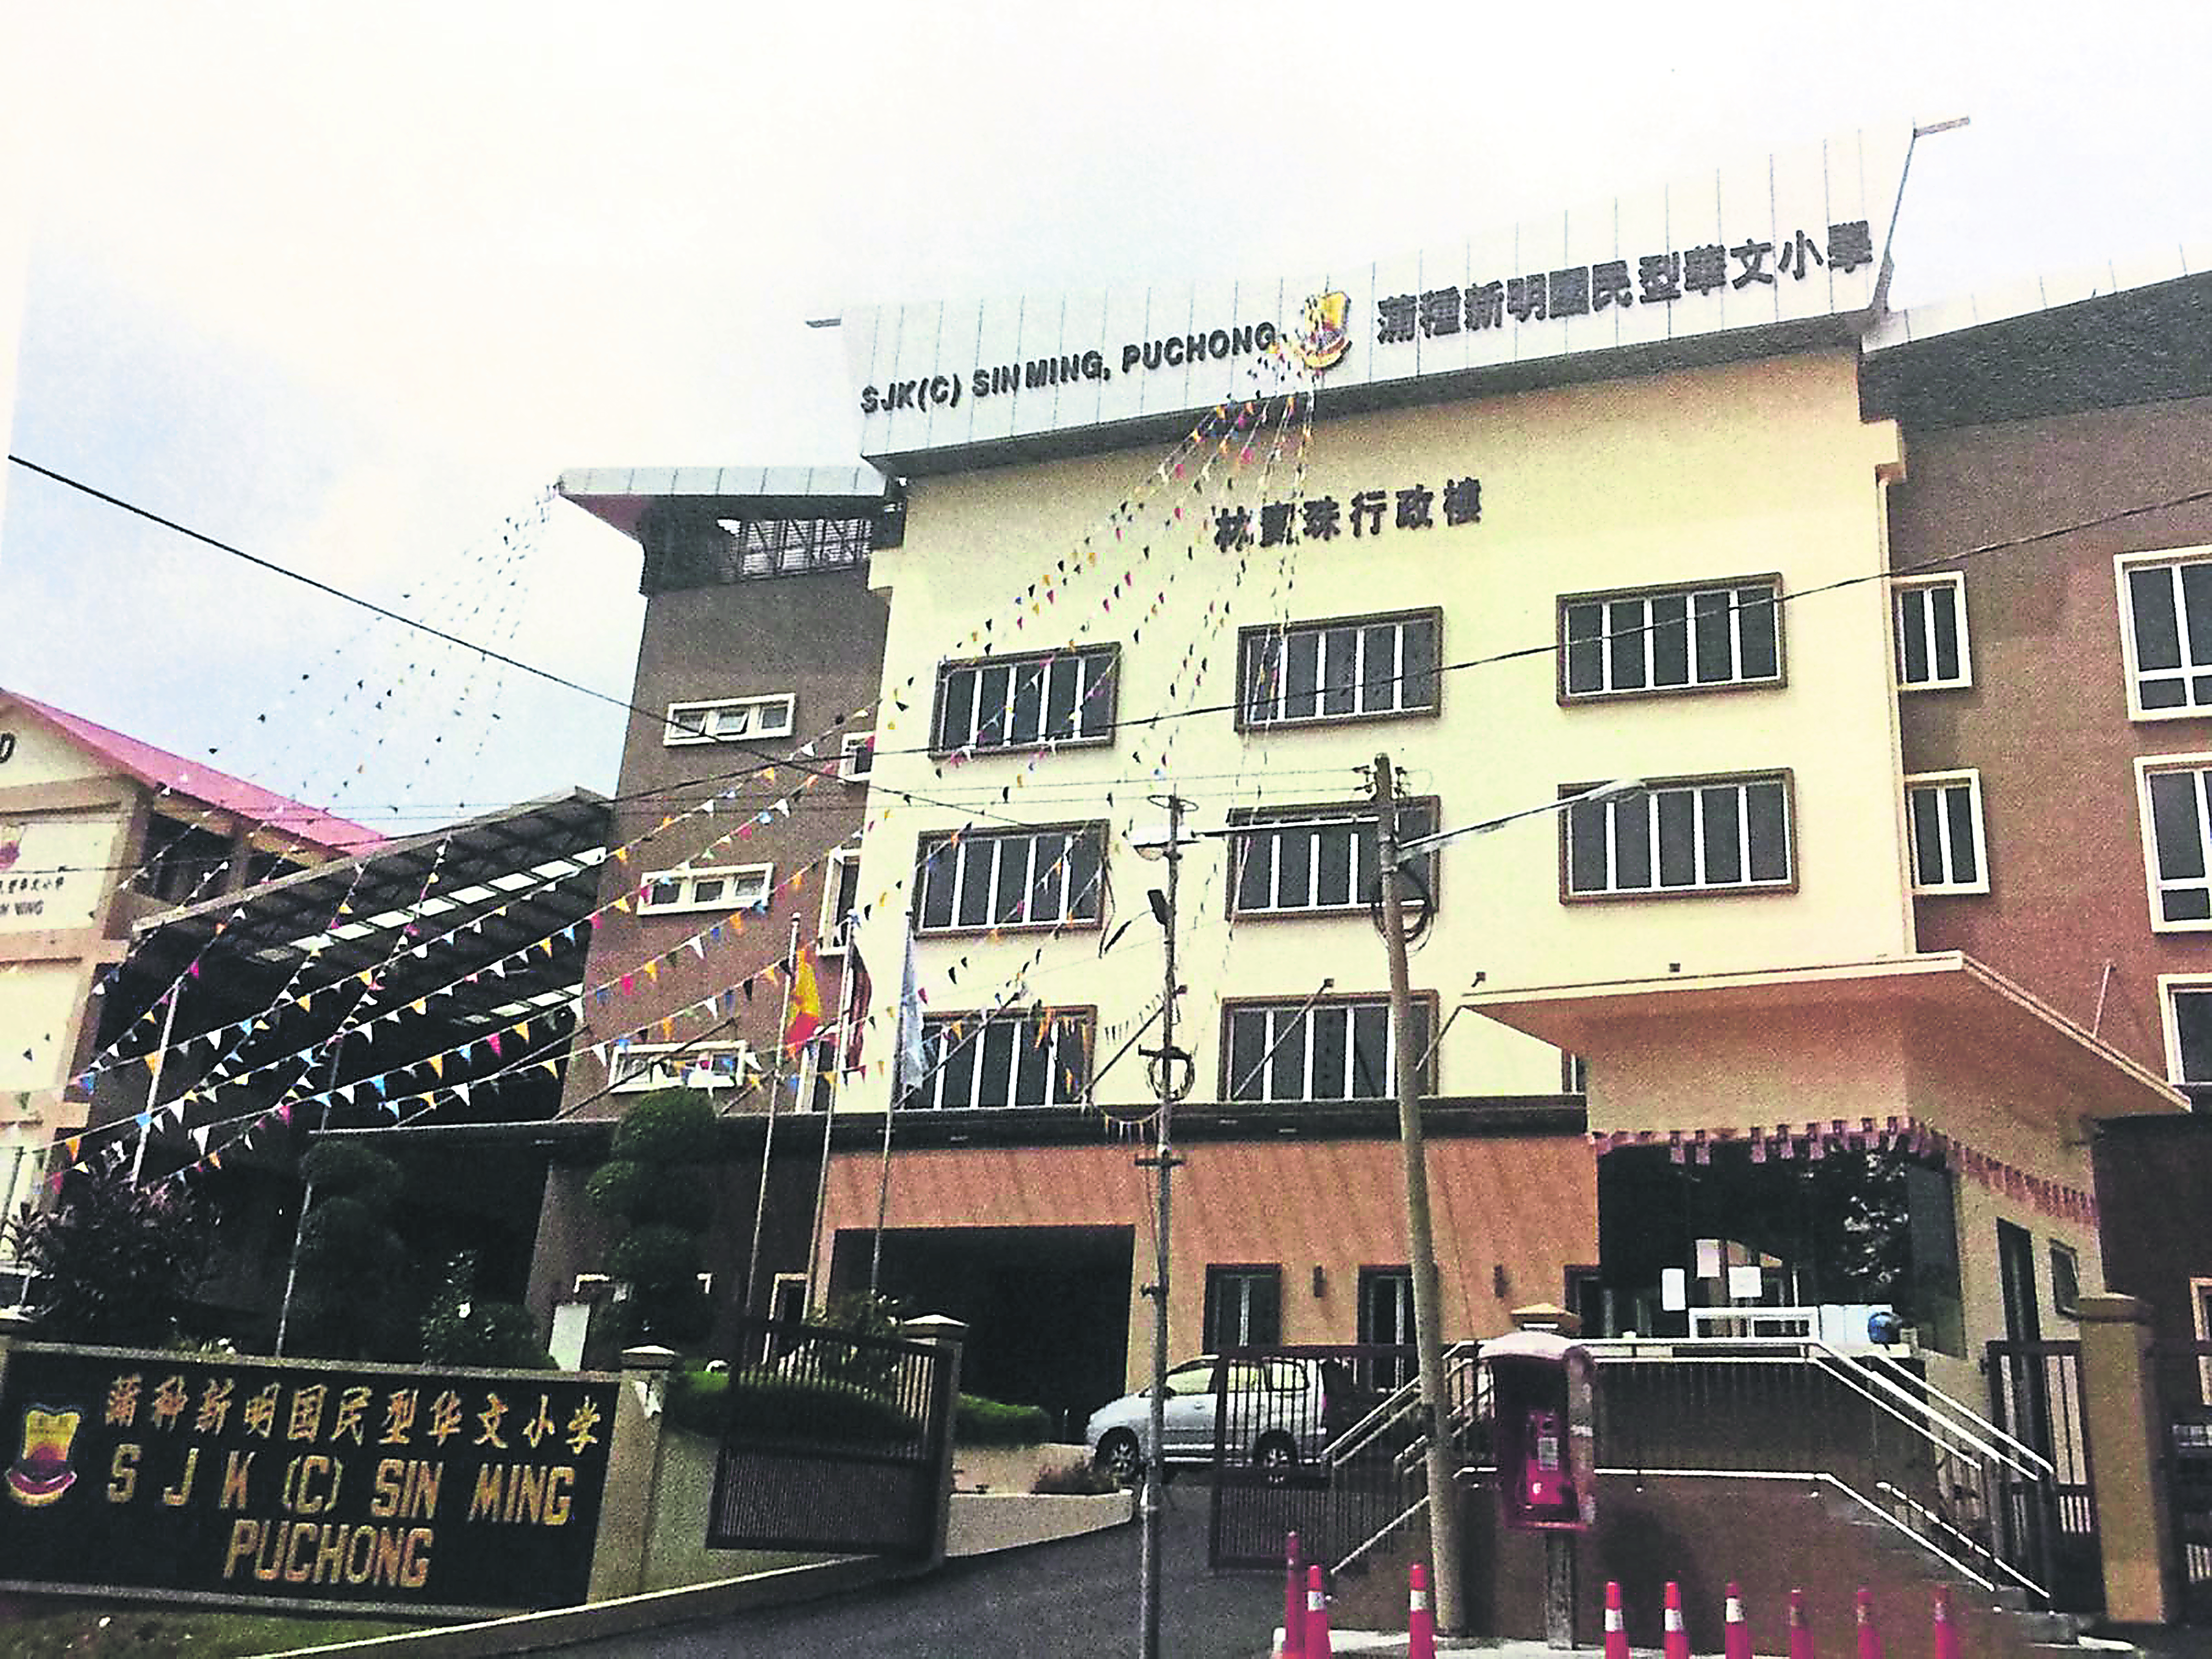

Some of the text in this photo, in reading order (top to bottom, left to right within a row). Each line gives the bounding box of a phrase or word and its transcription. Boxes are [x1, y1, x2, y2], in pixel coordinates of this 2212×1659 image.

[861, 321, 1277, 414] SJK(C) SIN MING, PUCHONG
[105, 1375, 601, 1454] 蒲种新明国民型华文小学
[282, 1455, 344, 1515] (C)
[371, 1458, 444, 1519] SIN
[467, 1463, 575, 1526] MING
[222, 1519, 433, 1587] PUCHONG
